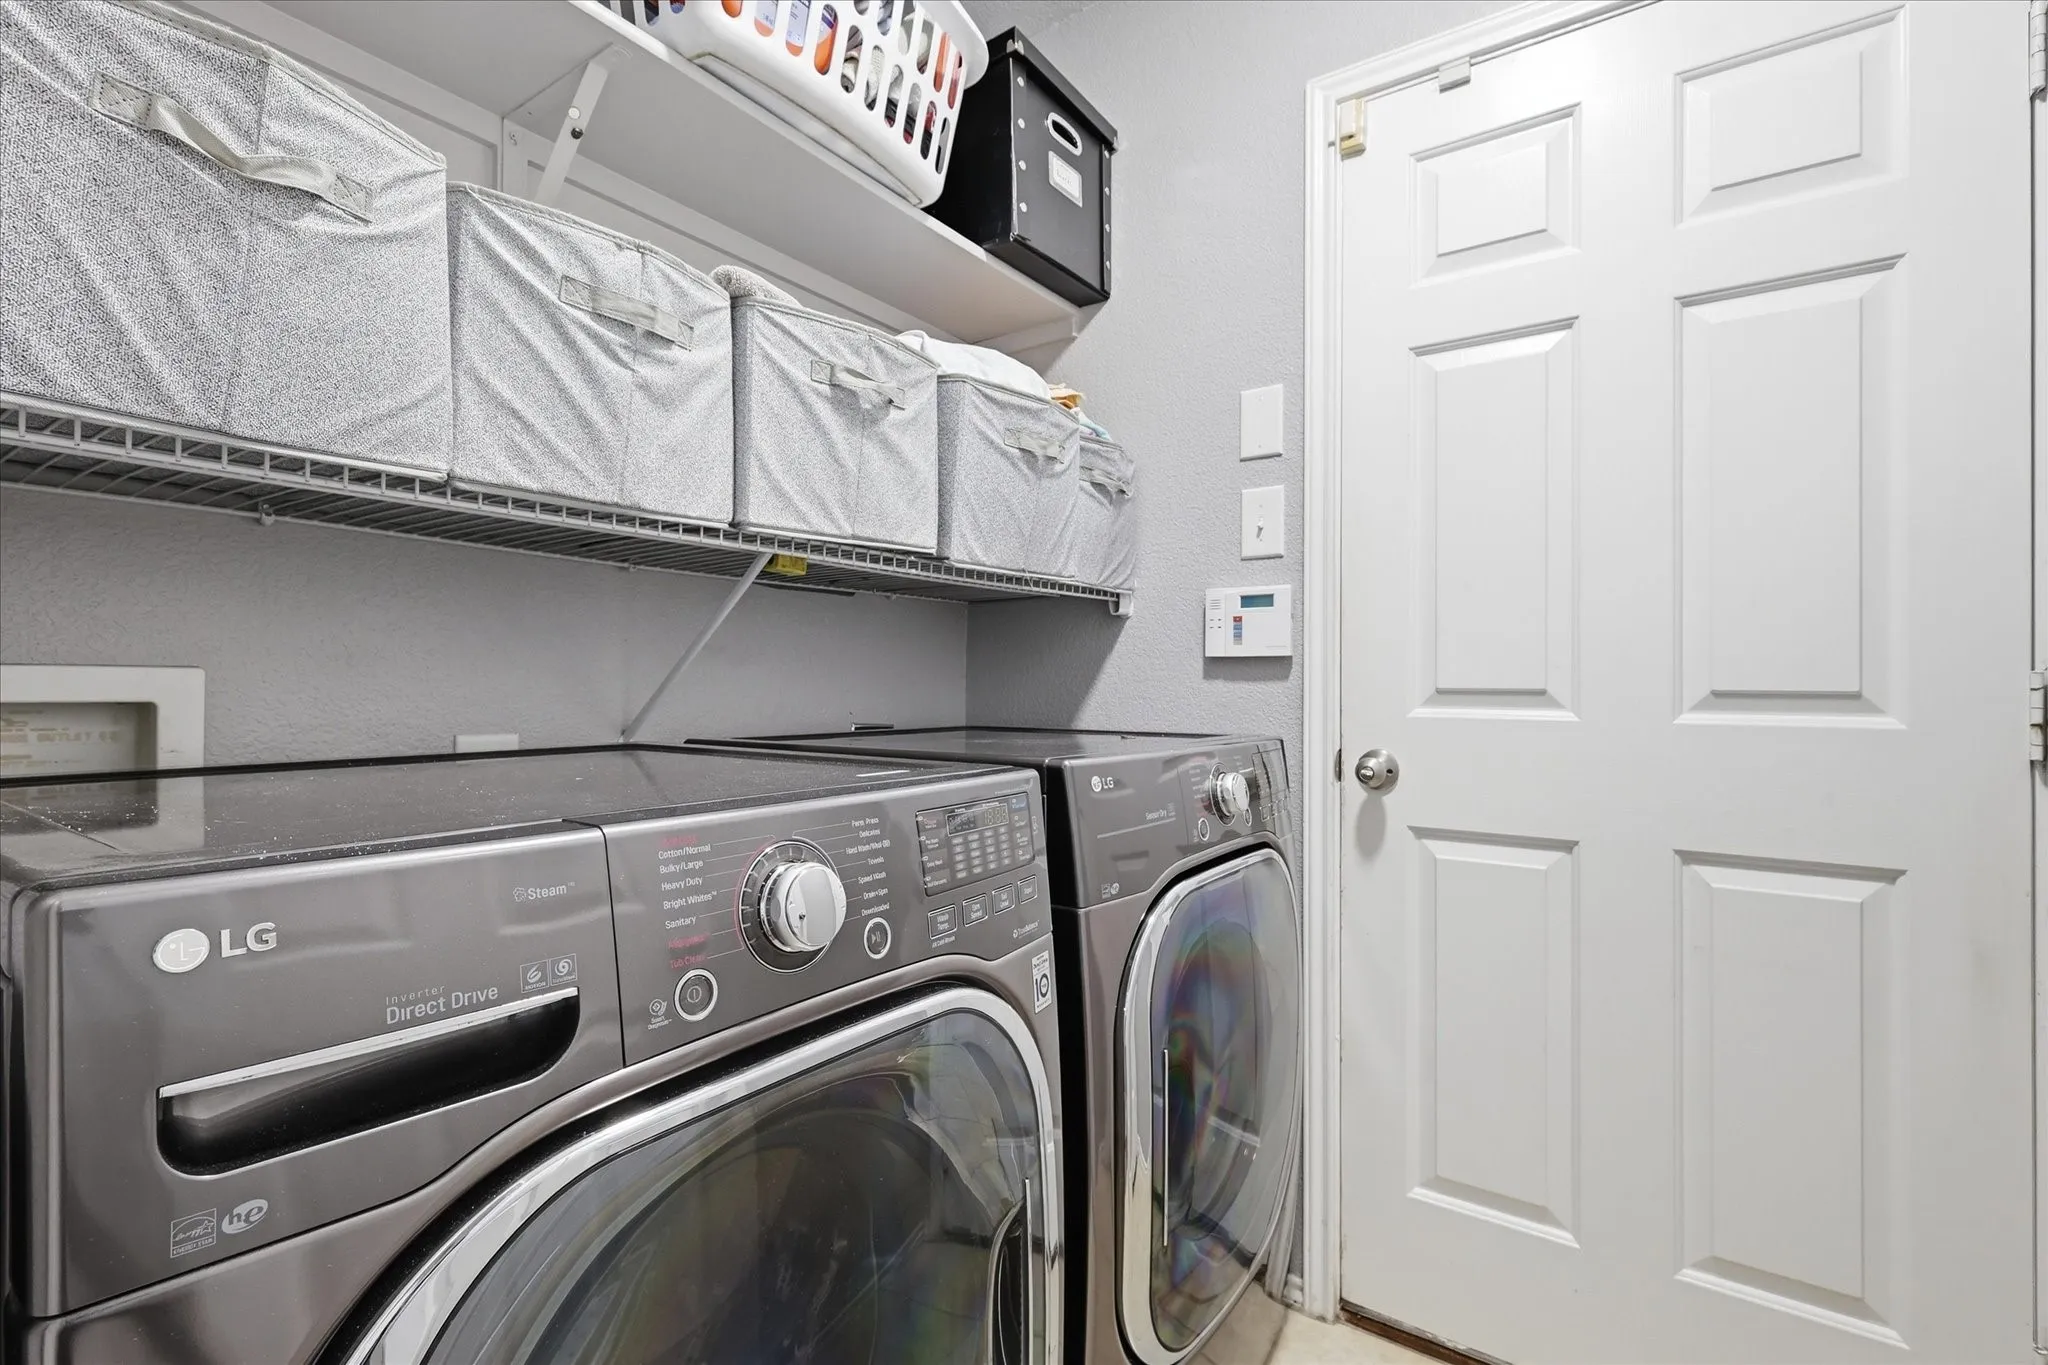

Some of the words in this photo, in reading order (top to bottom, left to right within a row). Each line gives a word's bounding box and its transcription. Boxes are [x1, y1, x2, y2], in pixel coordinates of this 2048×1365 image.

[1102, 777, 1114, 789] LG
[658, 843, 711, 859] Cotton/Normal
[659, 860, 704, 874] Bulky/Large
[867, 855, 885, 865] Towels
[661, 880, 685, 892] Heavy
[685, 877, 703, 887] Duty
[857, 874, 873, 884] Speed
[663, 897, 687, 910] Bright
[861, 902, 890, 917] Downloaded
[665, 916, 697, 929] Sanitary
[219, 921, 278, 959] LG
[385, 985, 445, 1006] Inverter
[385, 996, 446, 1025] Direct
[450, 986, 499, 1009] Drive
